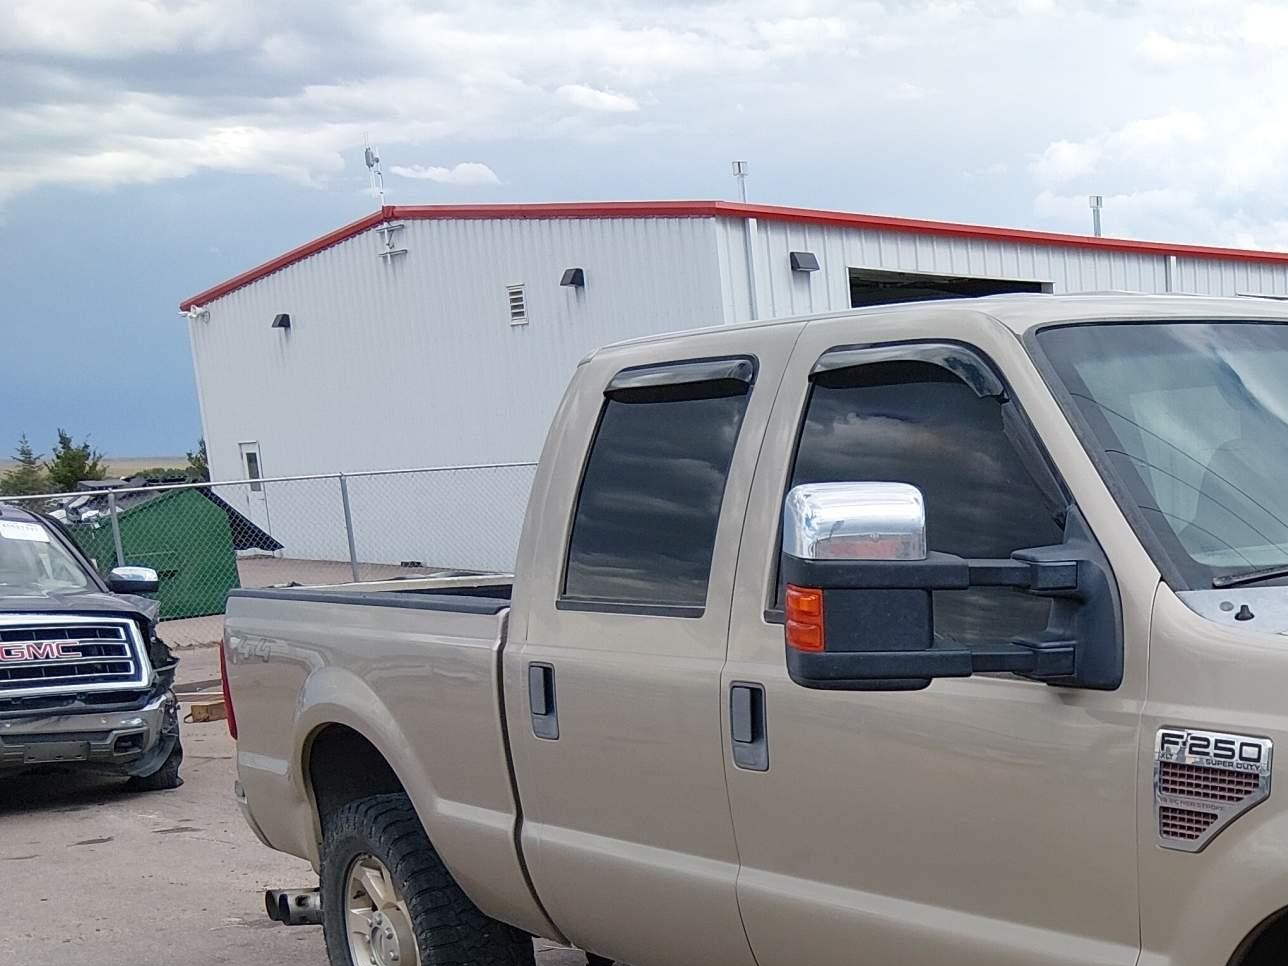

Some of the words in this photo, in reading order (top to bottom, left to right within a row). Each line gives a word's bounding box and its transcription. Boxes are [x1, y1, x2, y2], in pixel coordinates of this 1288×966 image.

[0, 641, 82, 661] GMC
[1205, 758, 1234, 768] SUPER
[1235, 762, 1261, 771] DUTY
